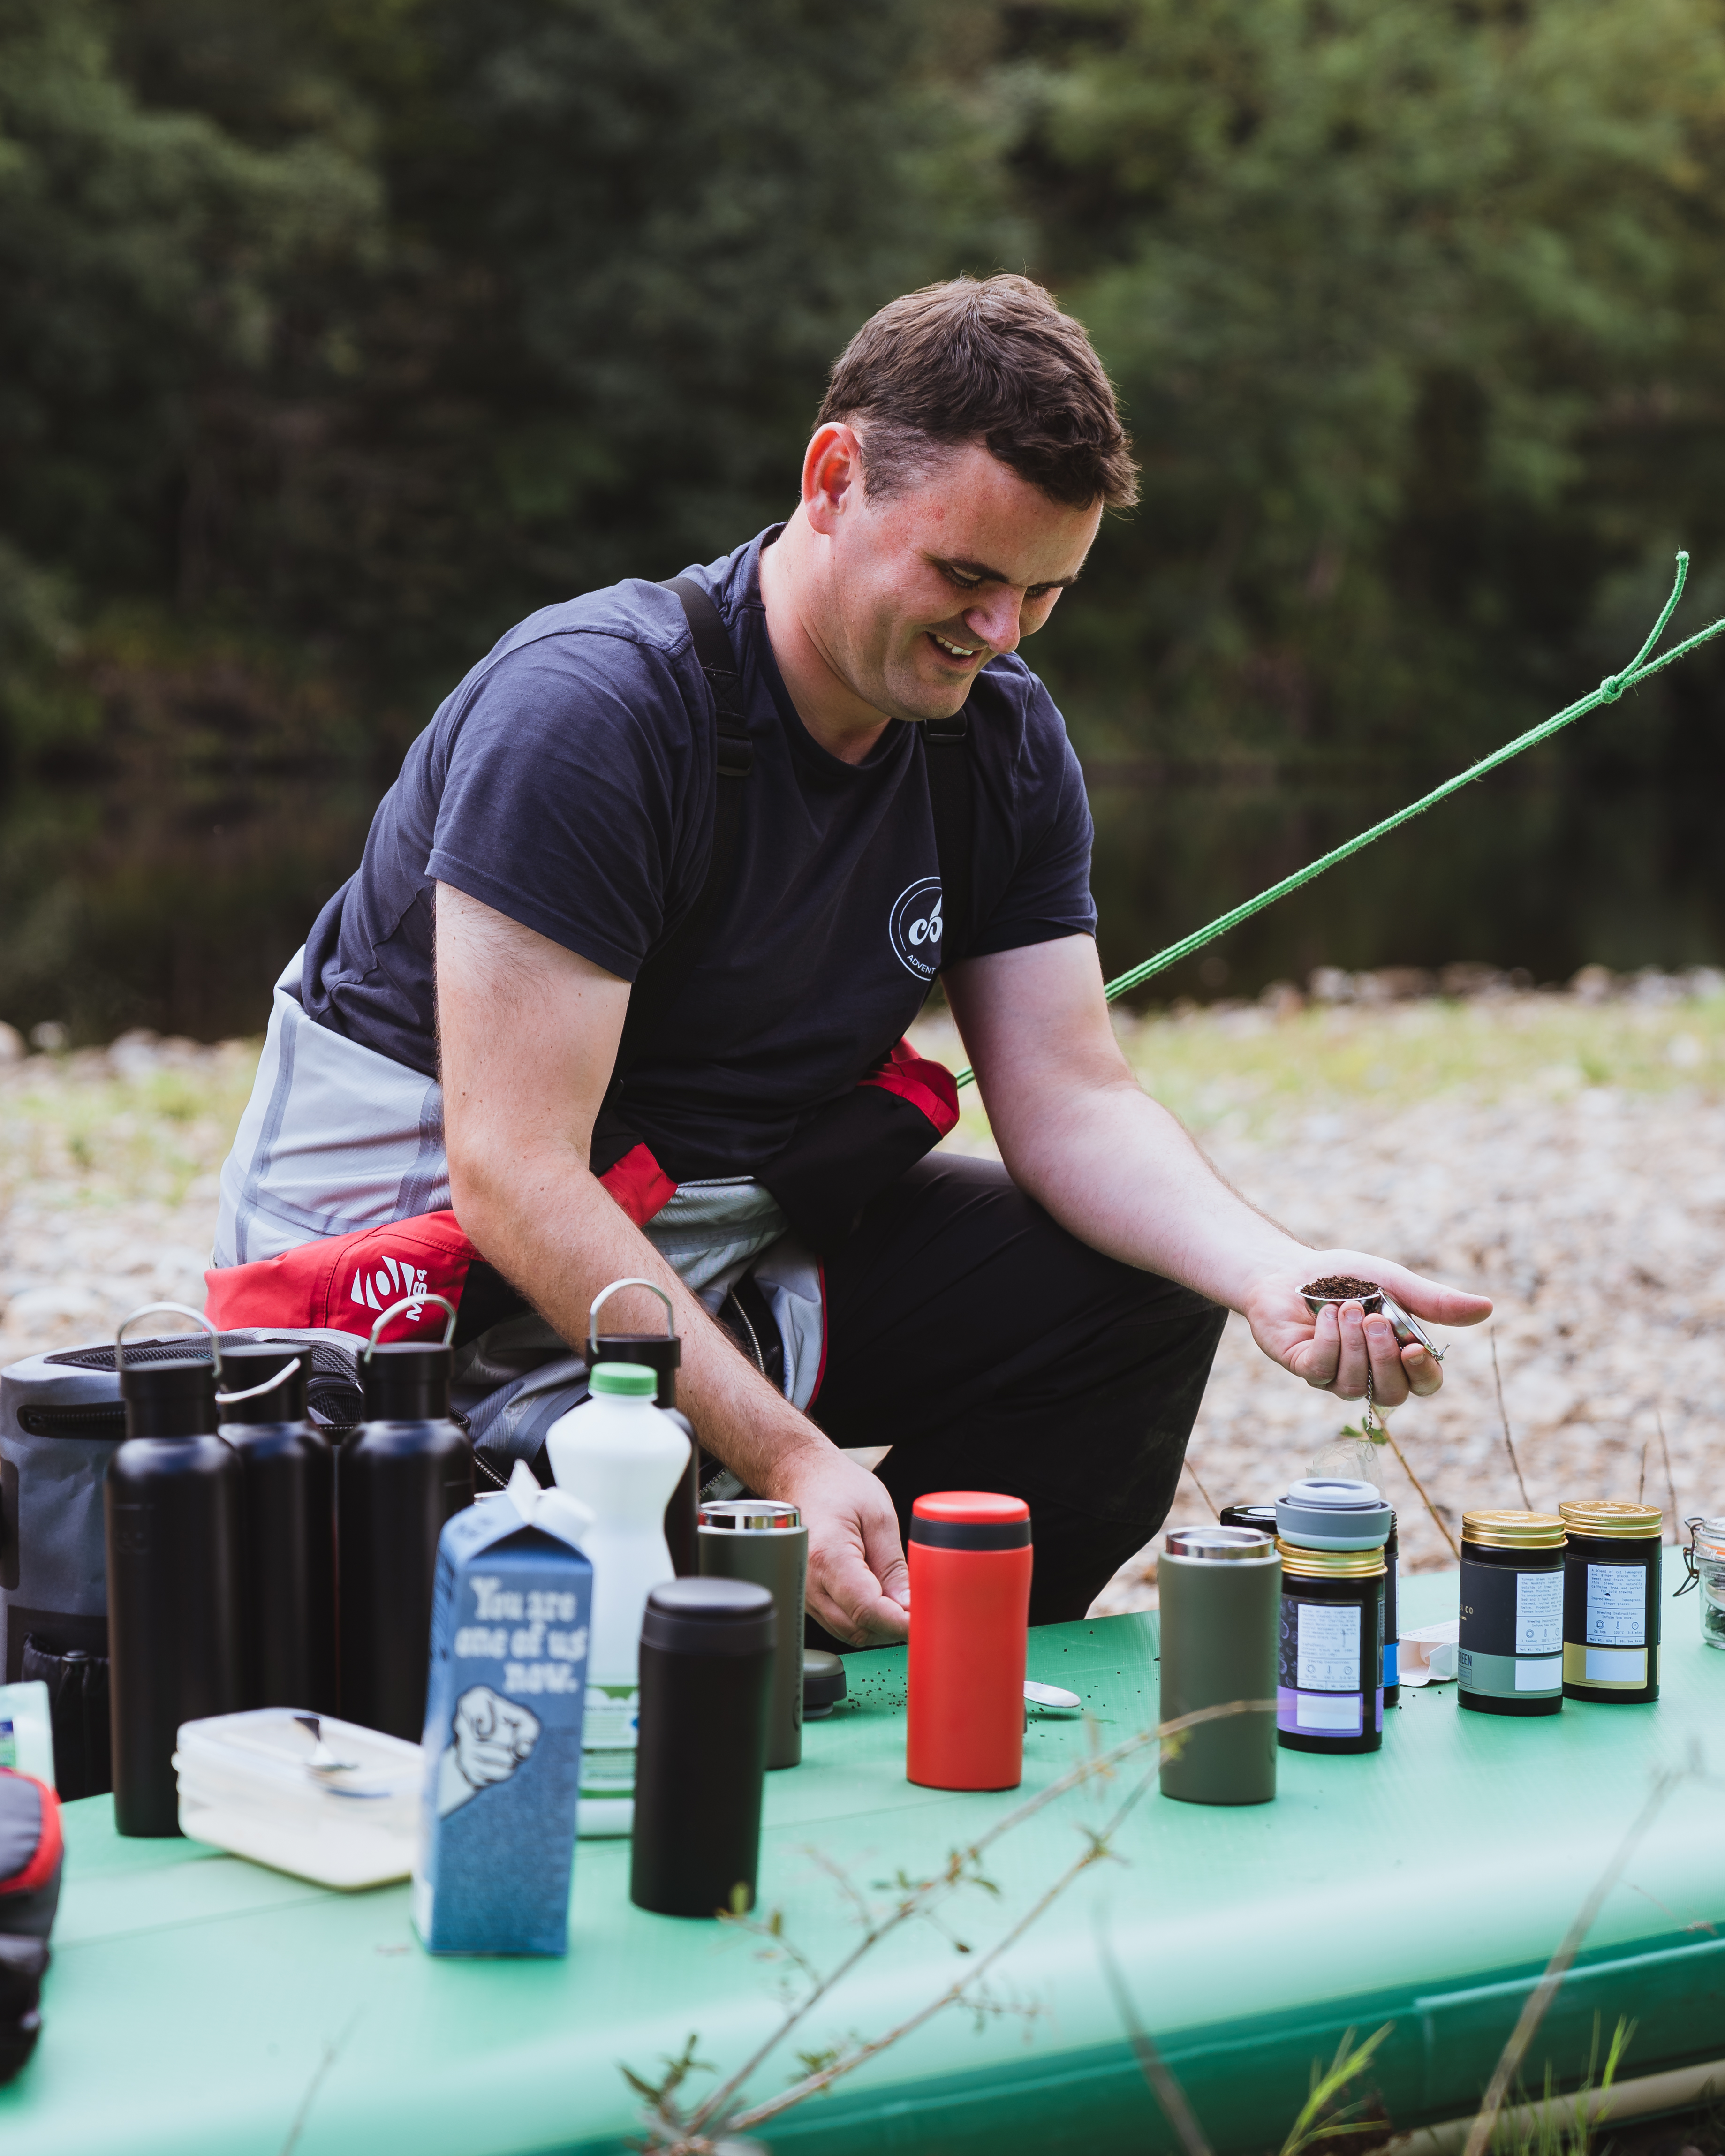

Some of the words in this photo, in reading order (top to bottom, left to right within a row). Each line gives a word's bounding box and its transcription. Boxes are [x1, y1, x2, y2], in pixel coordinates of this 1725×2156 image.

[907, 954, 936, 975] ADVENT
[469, 1575, 524, 1621] You
[526, 1590, 577, 1622] are
[1465, 1606, 1473, 1614] CO
[454, 1626, 509, 1660] one
[510, 1620, 546, 1659] of
[547, 1626, 588, 1662] us
[1458, 1651, 1472, 1666] REEN
[502, 1661, 579, 1695] now.
